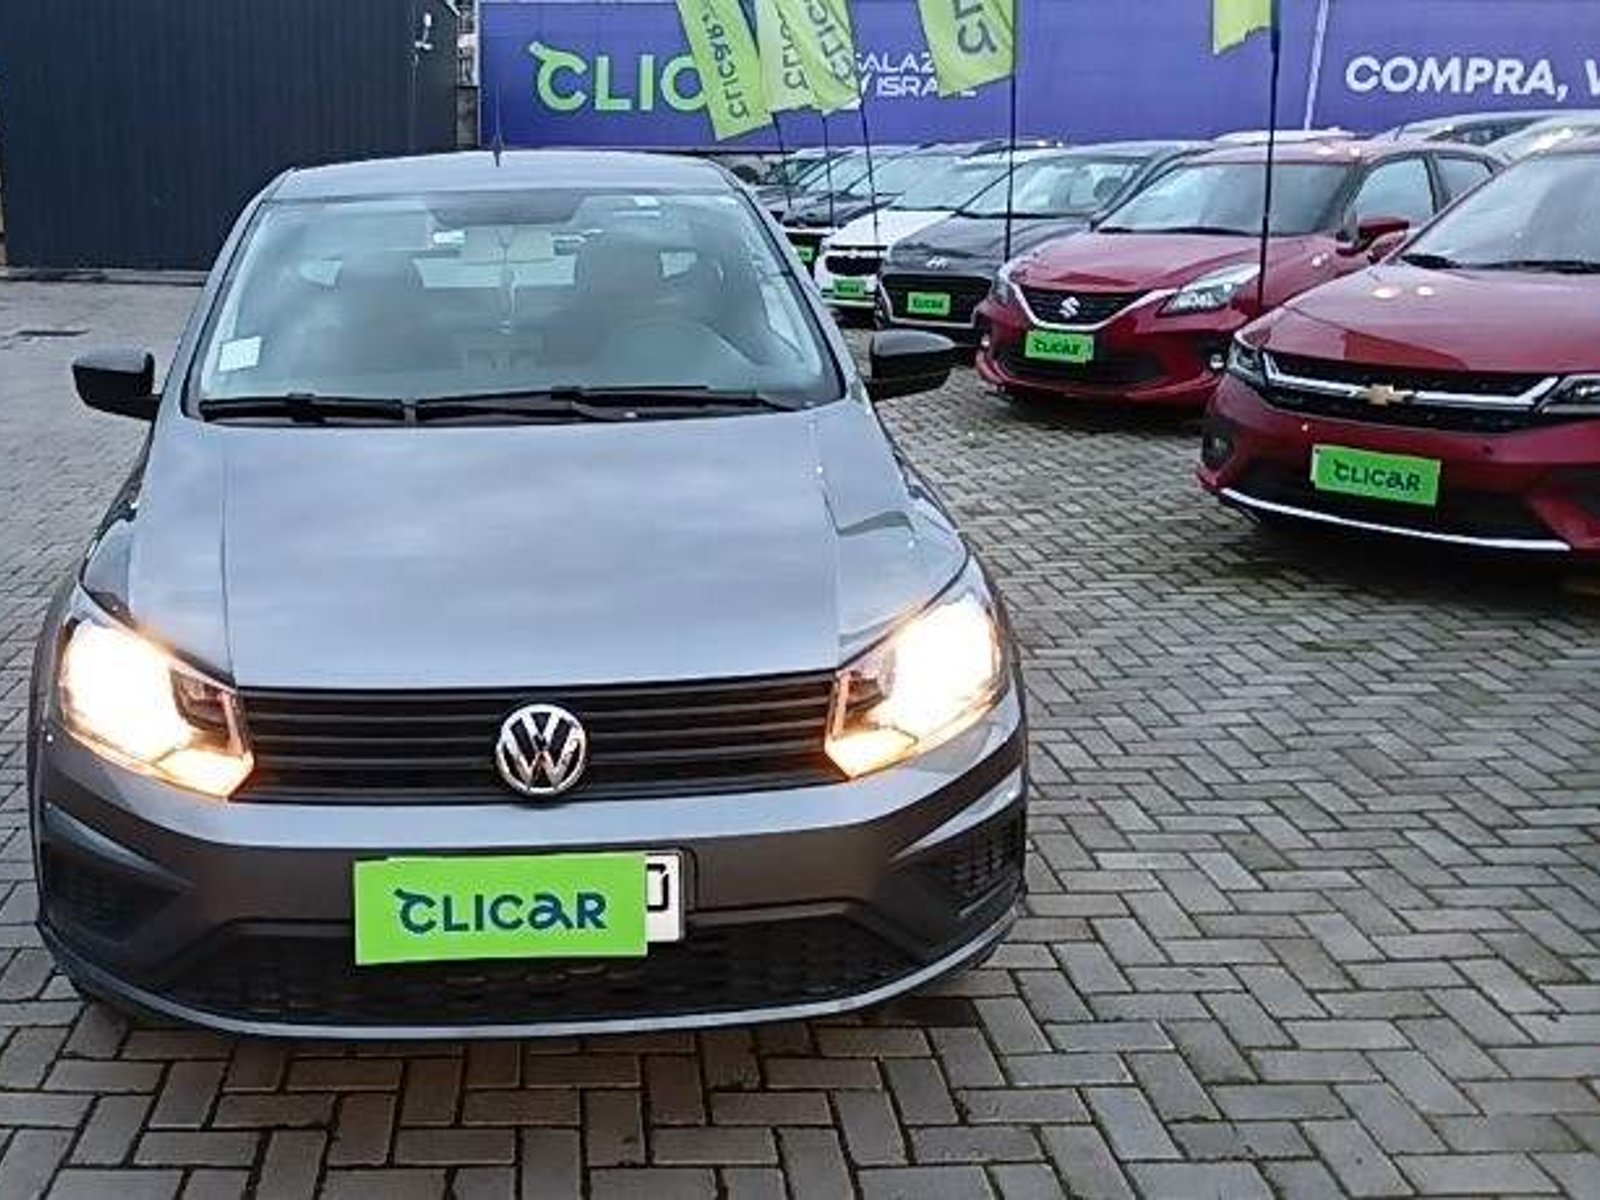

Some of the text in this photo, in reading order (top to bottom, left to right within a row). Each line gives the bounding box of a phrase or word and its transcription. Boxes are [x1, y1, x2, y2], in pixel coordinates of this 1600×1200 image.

[856, 52, 936, 74] ALAZ
[876, 74, 977, 97] ISRA
[1345, 55, 1568, 102] COMPRA,
